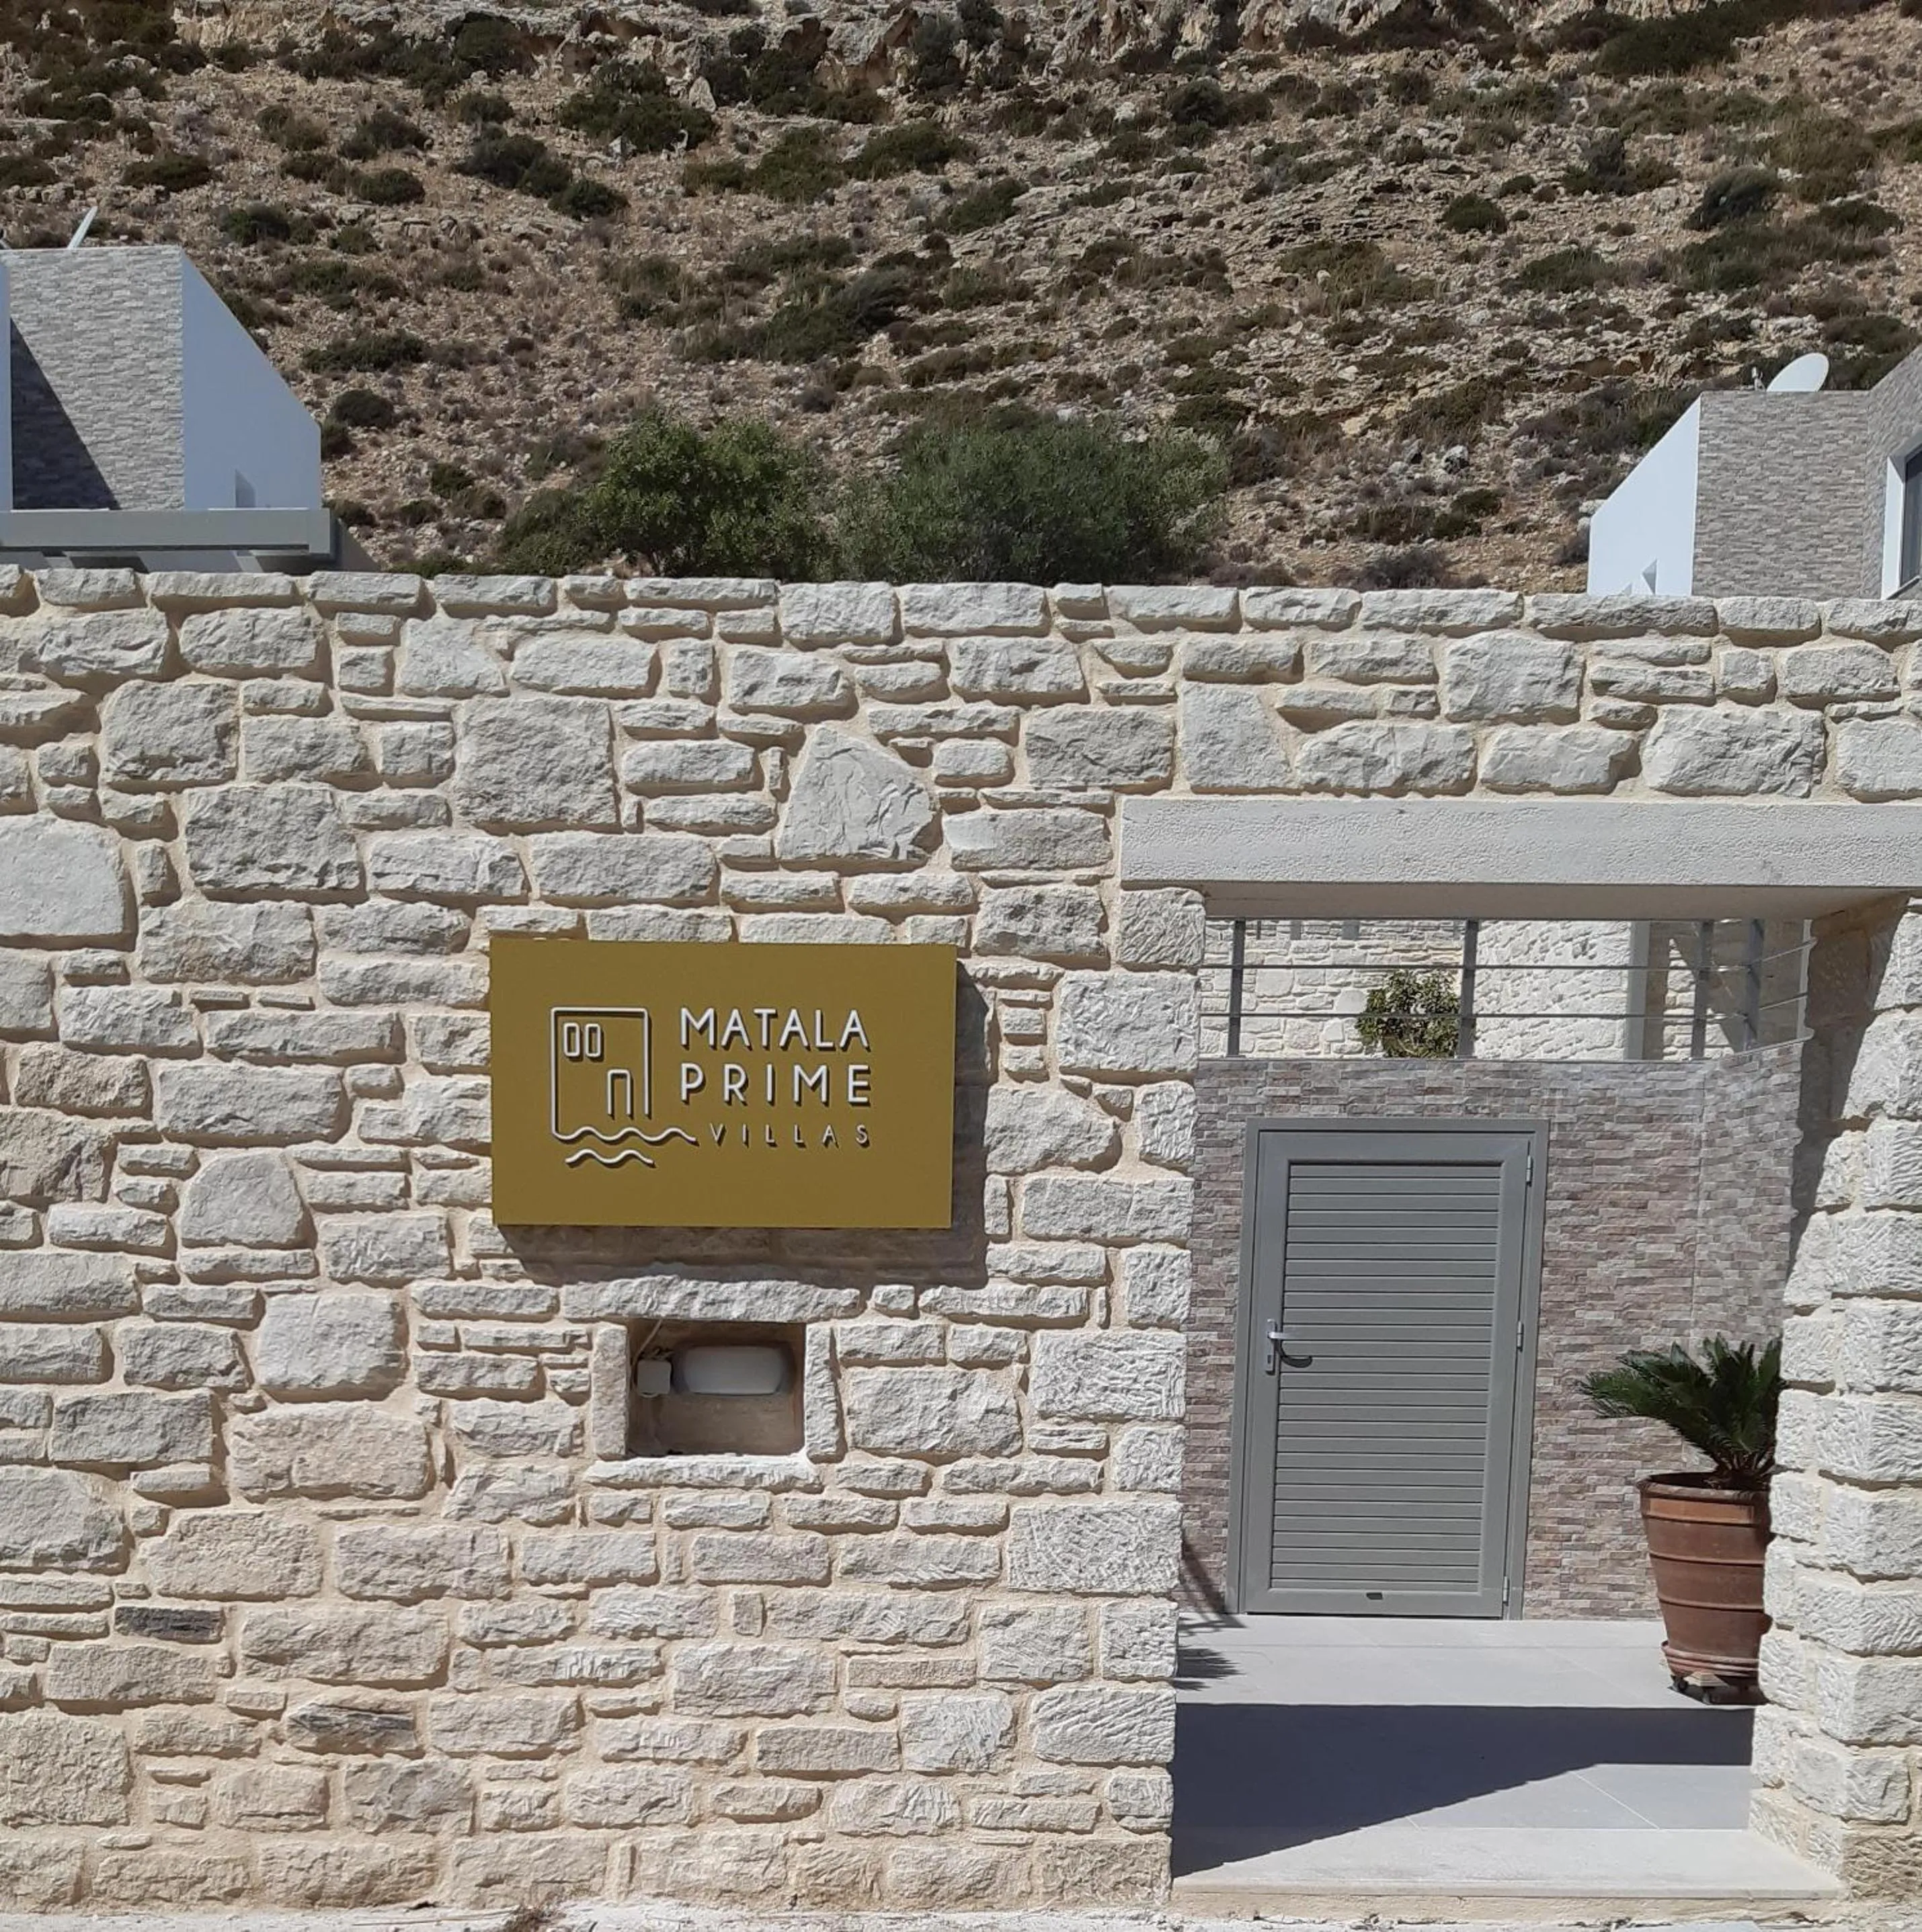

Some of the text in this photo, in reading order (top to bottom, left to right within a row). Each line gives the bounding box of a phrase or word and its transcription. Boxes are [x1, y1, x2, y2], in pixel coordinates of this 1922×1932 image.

[680, 1008, 870, 1048] MATALA
[680, 1063, 870, 1103] PRIME
[709, 1123, 870, 1145] VILLAS
